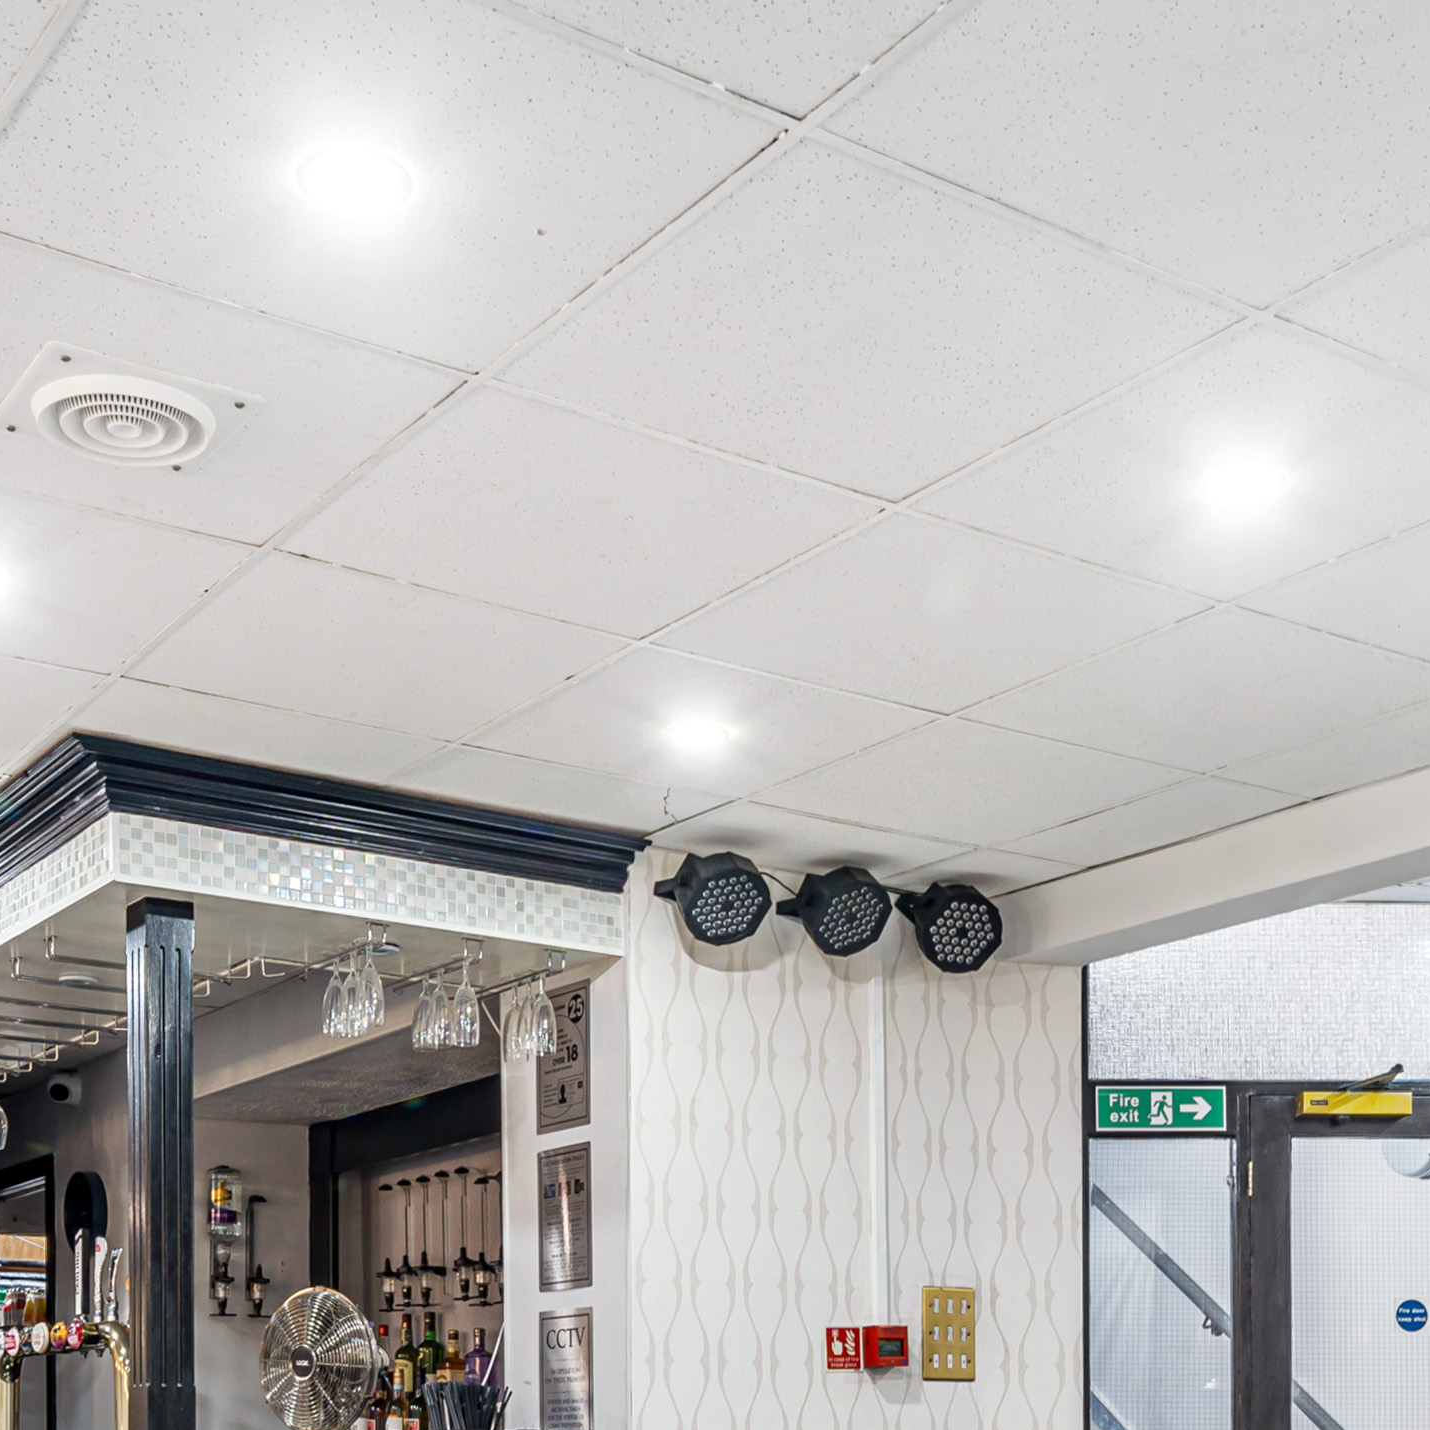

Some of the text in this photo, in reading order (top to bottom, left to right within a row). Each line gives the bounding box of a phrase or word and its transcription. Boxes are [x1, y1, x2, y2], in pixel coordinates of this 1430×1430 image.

[569, 998, 583, 1019] 25
[552, 1056, 565, 1066] OVER
[566, 1044, 578, 1062] 18
[1109, 1093, 1140, 1107] Fire
[1110, 1108, 1140, 1123] exit
[546, 1327, 586, 1350] CCTV
